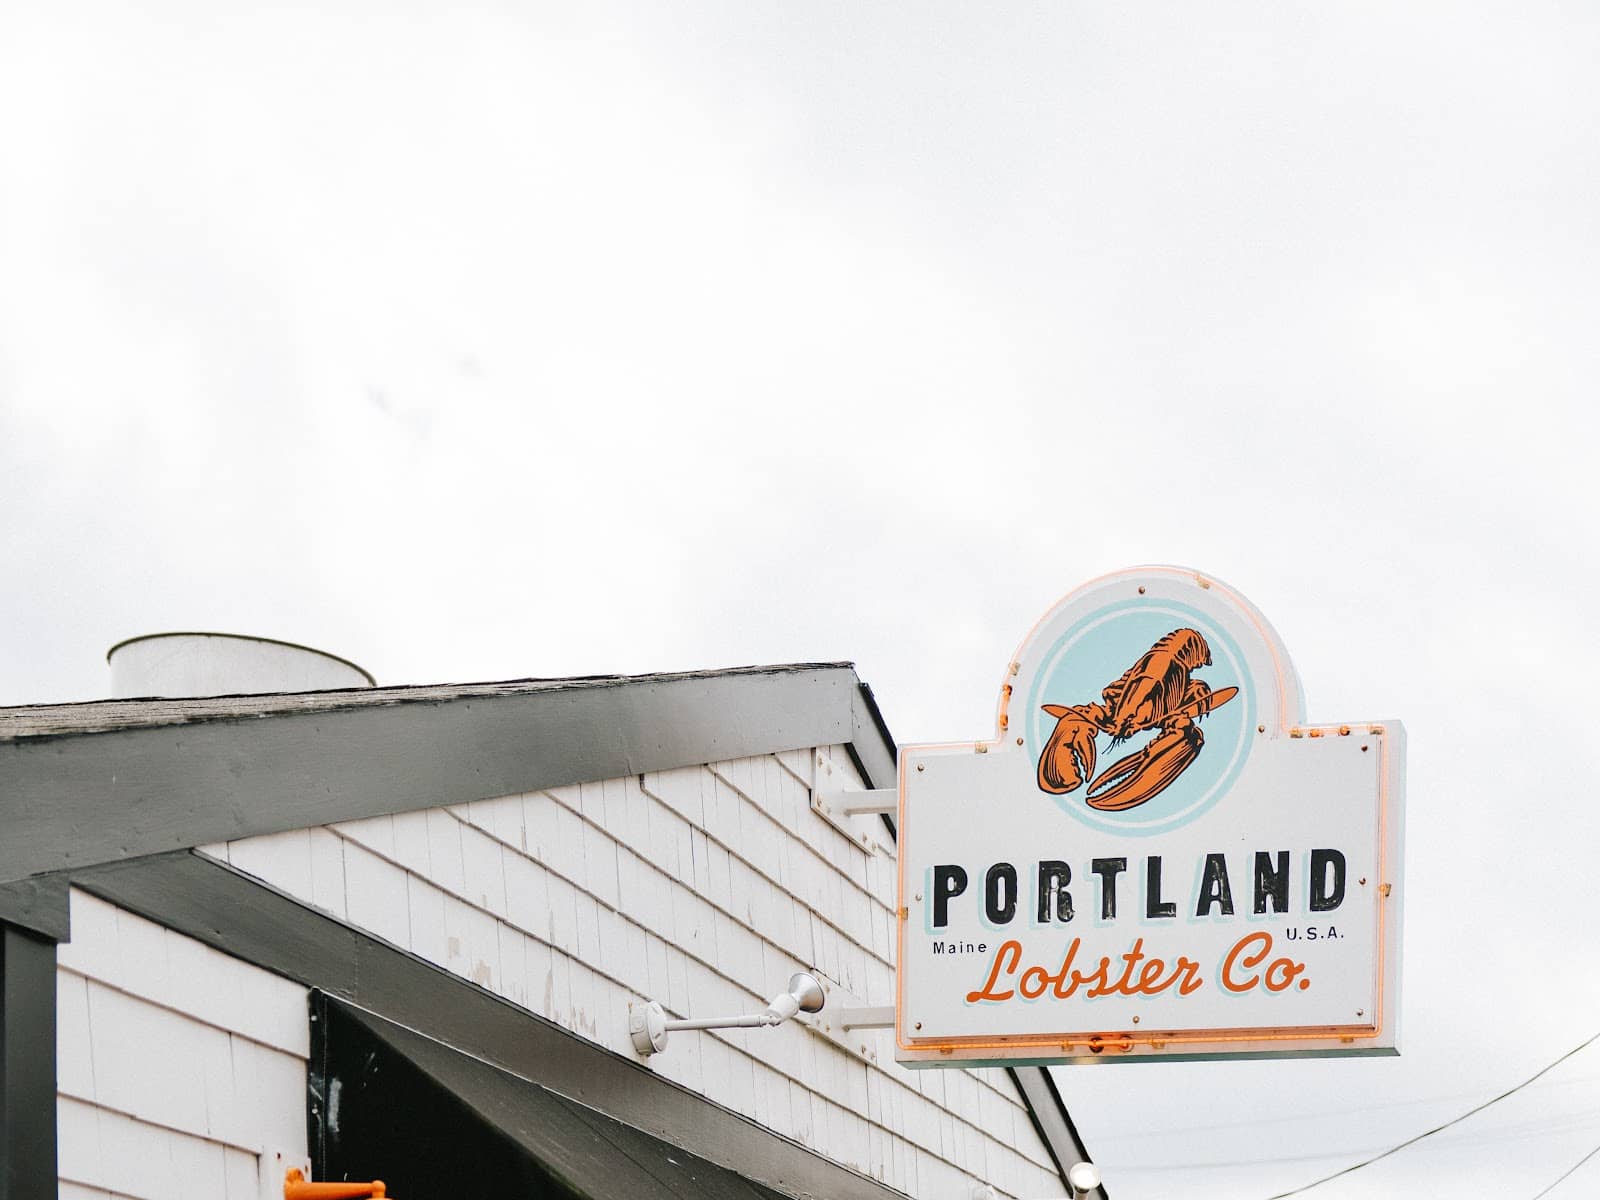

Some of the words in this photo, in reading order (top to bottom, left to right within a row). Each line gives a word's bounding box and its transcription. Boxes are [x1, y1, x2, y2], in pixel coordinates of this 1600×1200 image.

[930, 848, 1347, 927] PORTLAND
[932, 940, 987, 955] Maine
[1286, 927, 1344, 941] U.S.A.
[965, 937, 1204, 1004] Lobster
[1221, 932, 1311, 993] Co.
